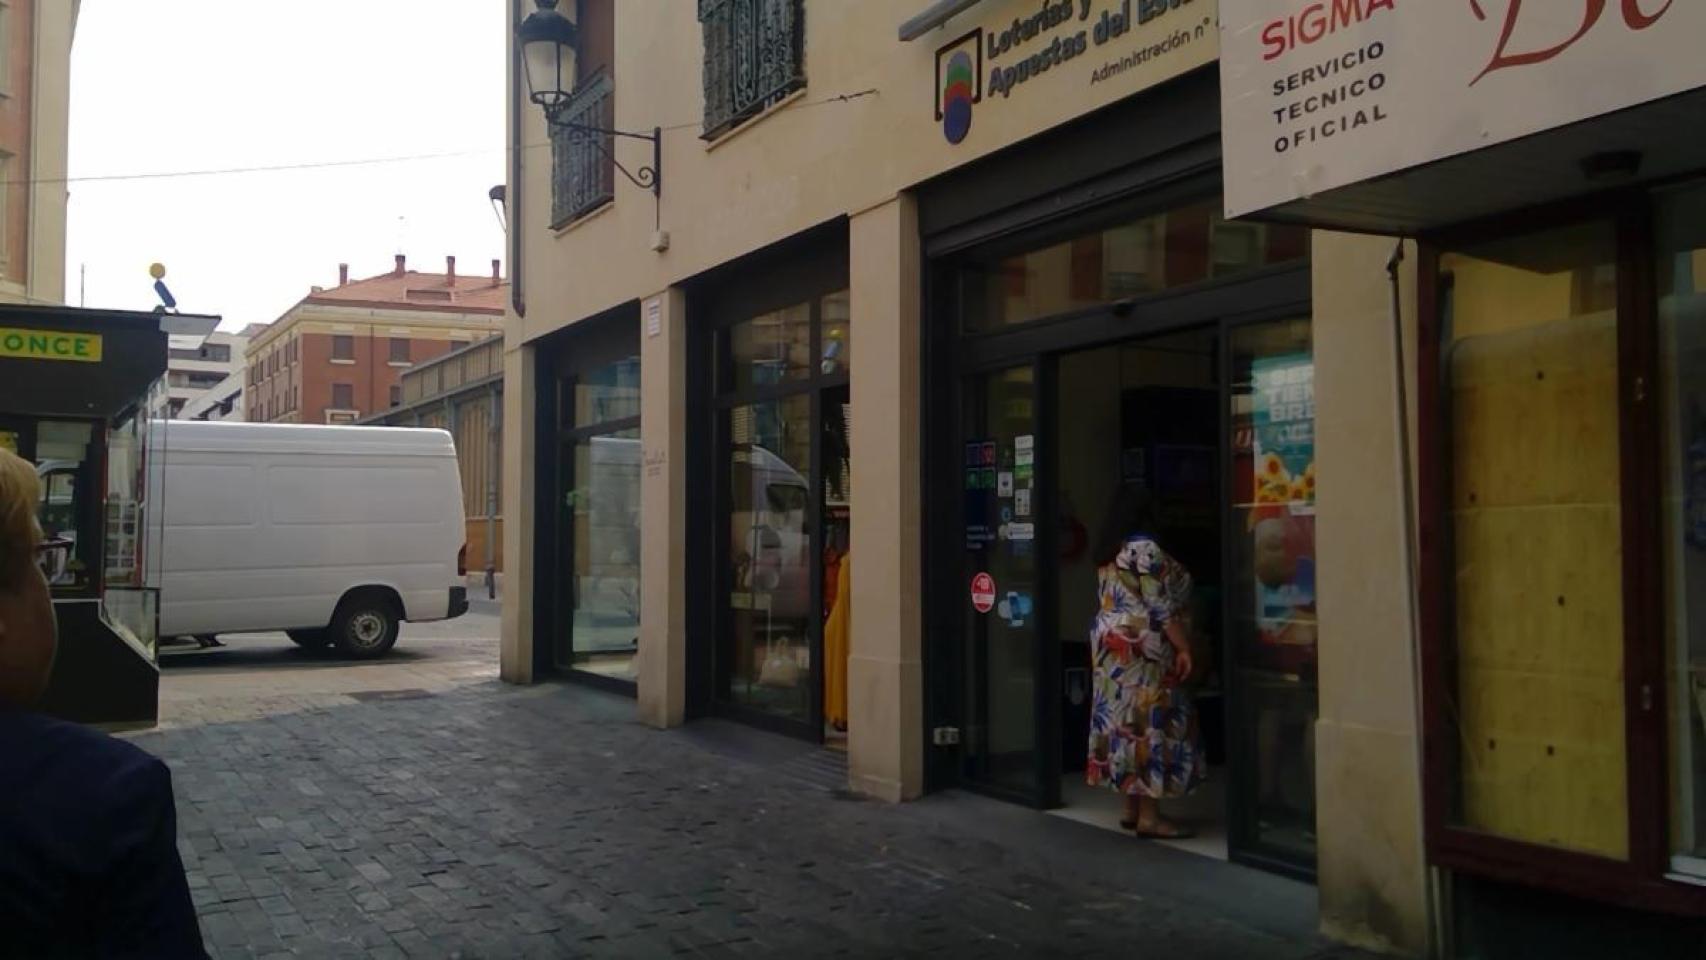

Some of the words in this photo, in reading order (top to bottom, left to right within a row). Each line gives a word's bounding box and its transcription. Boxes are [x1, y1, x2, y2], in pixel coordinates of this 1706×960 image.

[988, 30, 1088, 98] Apuestas
[1093, 0, 1131, 46] del
[1090, 28, 1191, 85] Administración
[1261, 0, 1395, 61] SIGMA
[1273, 41, 1384, 96] SERVICIO
[1273, 73, 1386, 124] TECNICO
[1274, 104, 1387, 153] OFICIAL
[4, 334, 90, 356] ONCE
